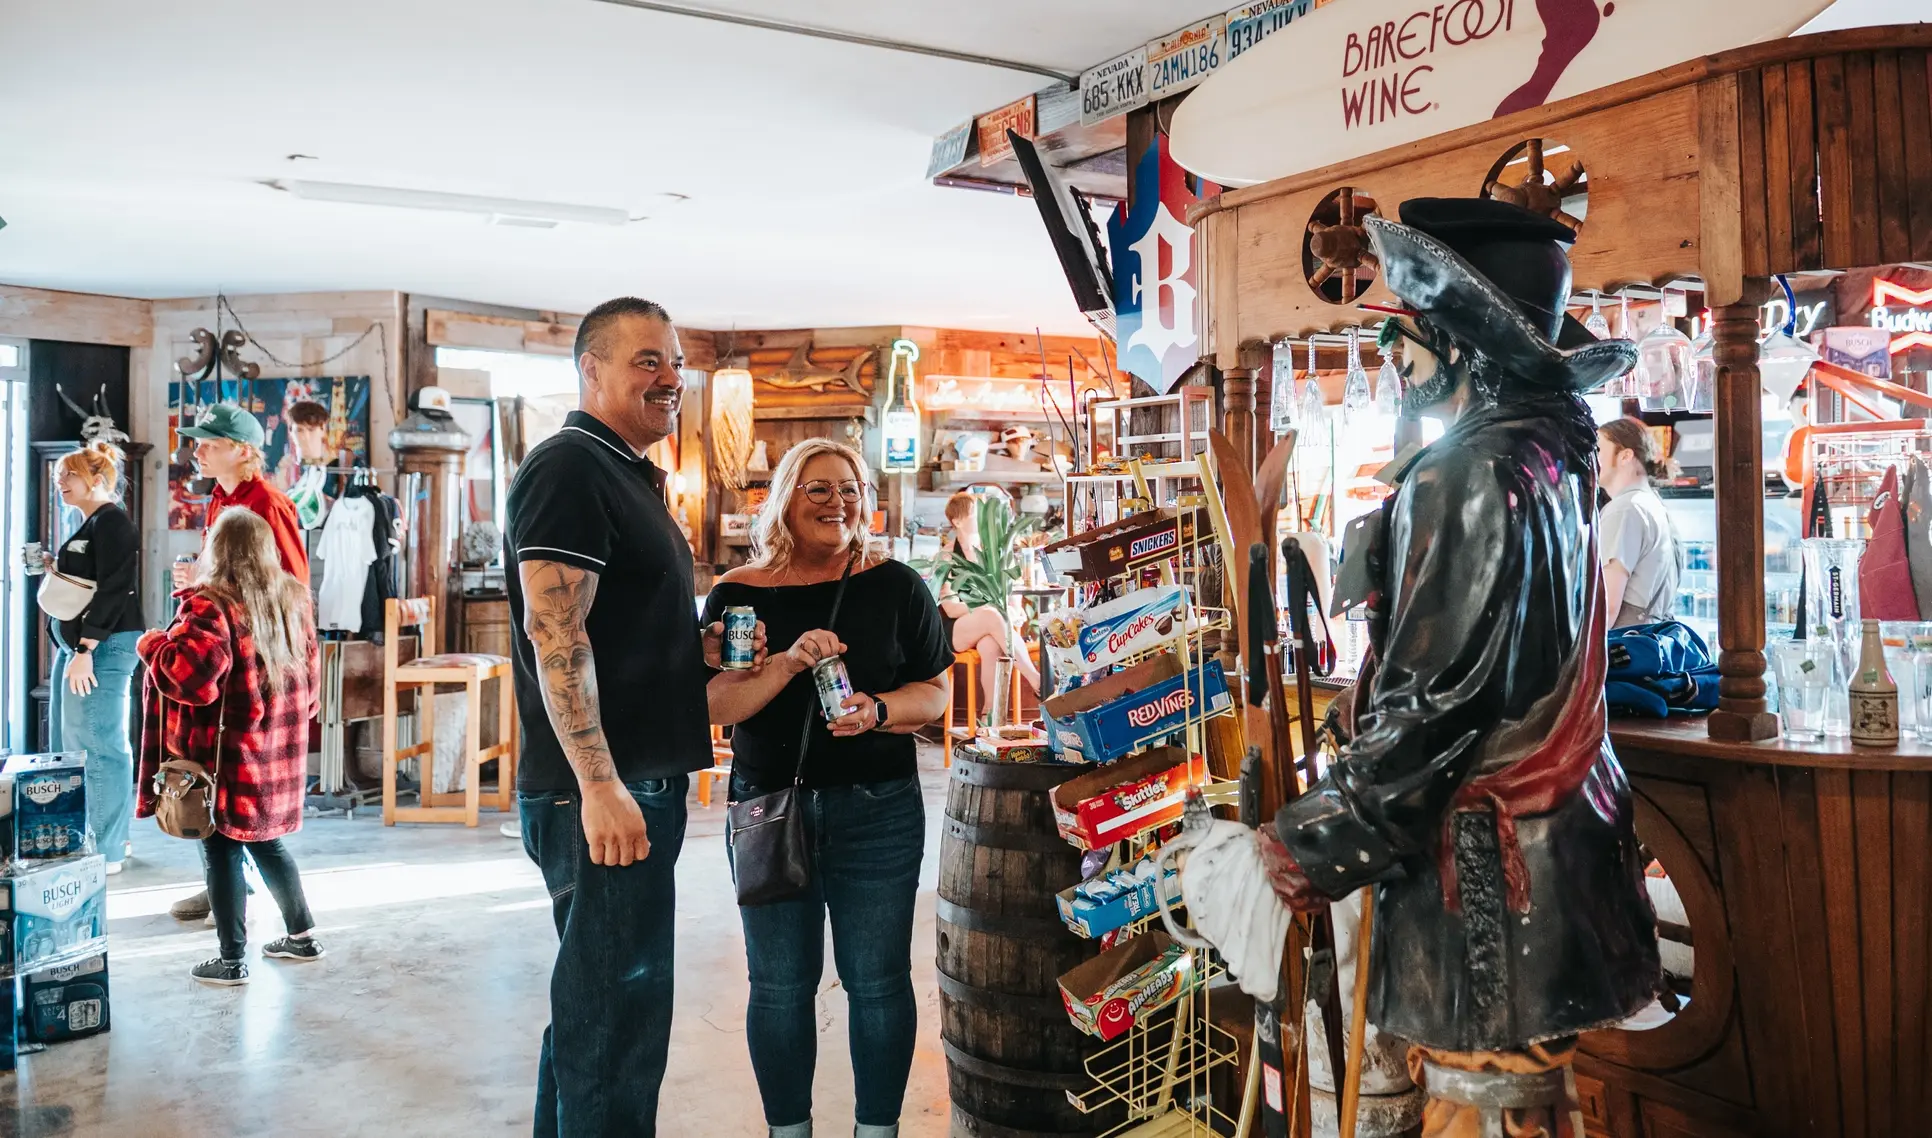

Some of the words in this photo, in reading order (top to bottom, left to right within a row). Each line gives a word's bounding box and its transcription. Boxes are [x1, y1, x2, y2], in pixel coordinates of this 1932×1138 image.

[1165, 28, 1206, 52] CALIFORNIA
[1097, 59, 1129, 80] NEVADA
[1153, 39, 1218, 90] 2AMW186
[1342, 65, 1433, 131] WINE
[1846, 339, 1872, 347] BUSCH
[1132, 531, 1175, 556] SNICKERS
[728, 630, 754, 641] BUSC
[1088, 653, 1096, 661] 16
[26, 784, 61, 796] BUSCH
[1122, 781, 1167, 811] Skittles
[43, 881, 82, 905] BUSCH
[51, 897, 75, 910] LIGHT
[50, 963, 80, 976] BUSCH
[1128, 971, 1174, 1016] AIRHEADS
